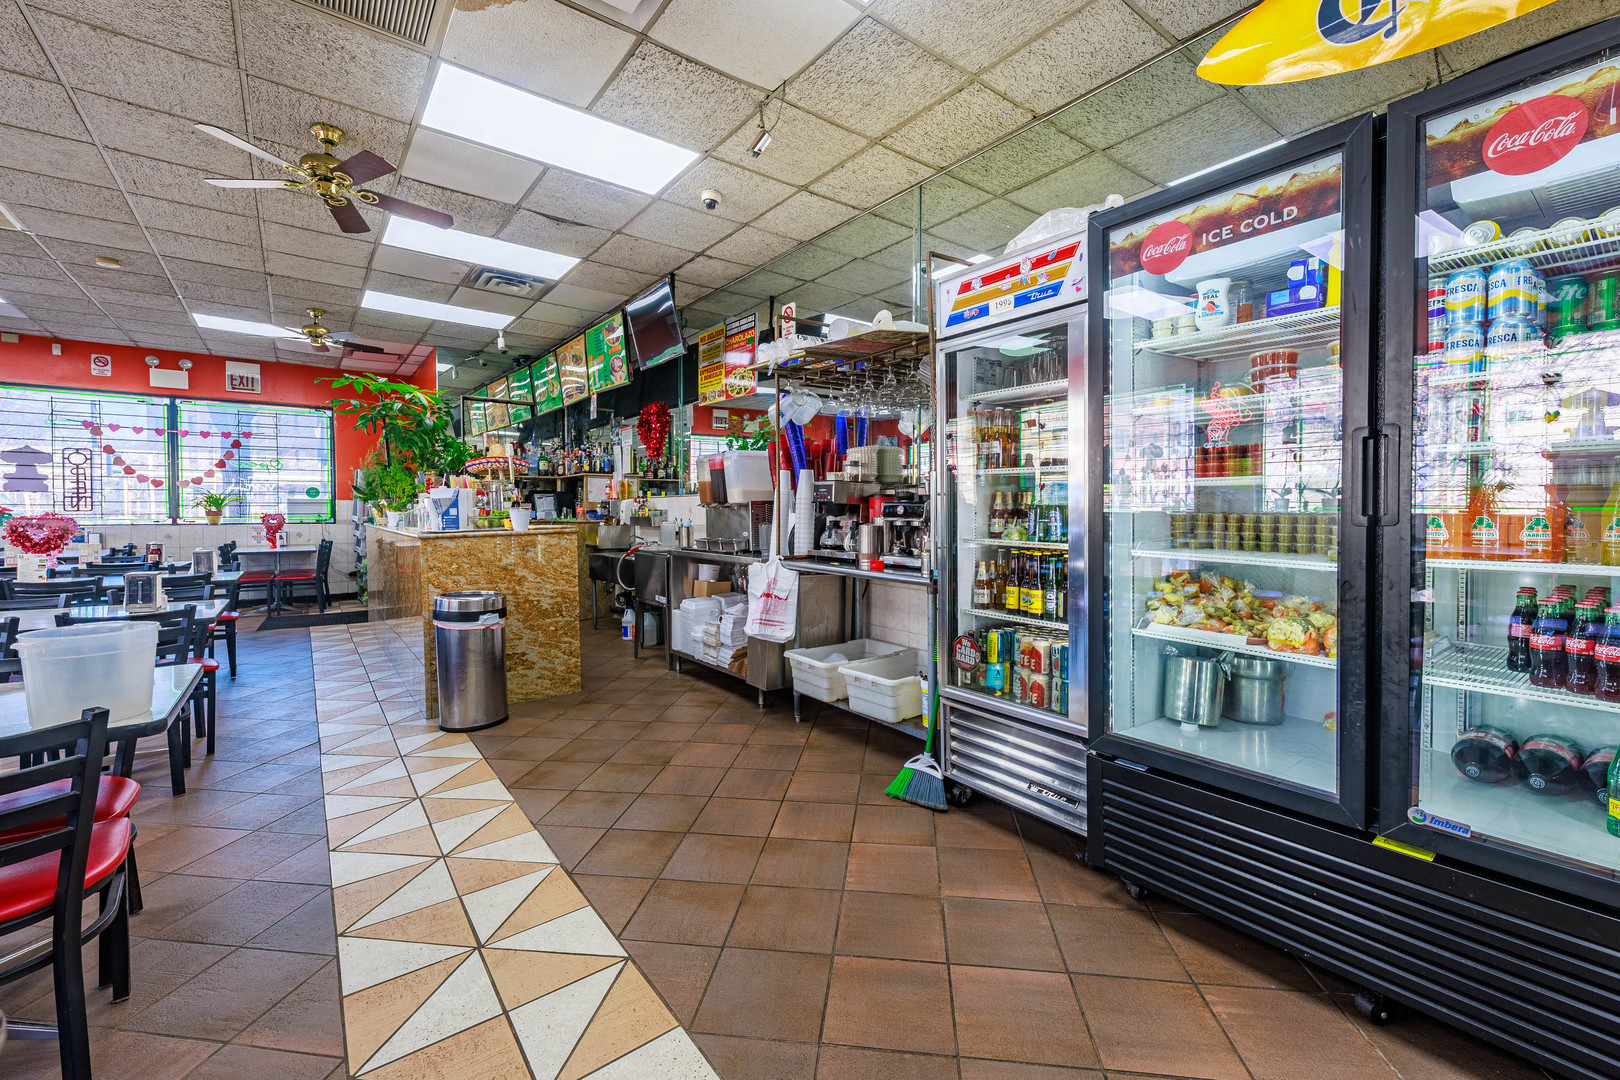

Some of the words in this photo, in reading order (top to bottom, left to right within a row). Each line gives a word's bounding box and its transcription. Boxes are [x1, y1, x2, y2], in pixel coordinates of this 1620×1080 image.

[1488, 110, 1583, 158] Coca-Cola
[1202, 224, 1234, 246] ICE
[1240, 206, 1298, 234] COLD
[1142, 232, 1190, 262] Coca-Cola
[1027, 289, 1055, 301] True
[1446, 338, 1480, 351] FRESCA
[230, 374, 255, 388] EXIT
[956, 644, 976, 658] CARD
[956, 652, 975, 666] HARD
[1428, 816, 1470, 836] Imbera
